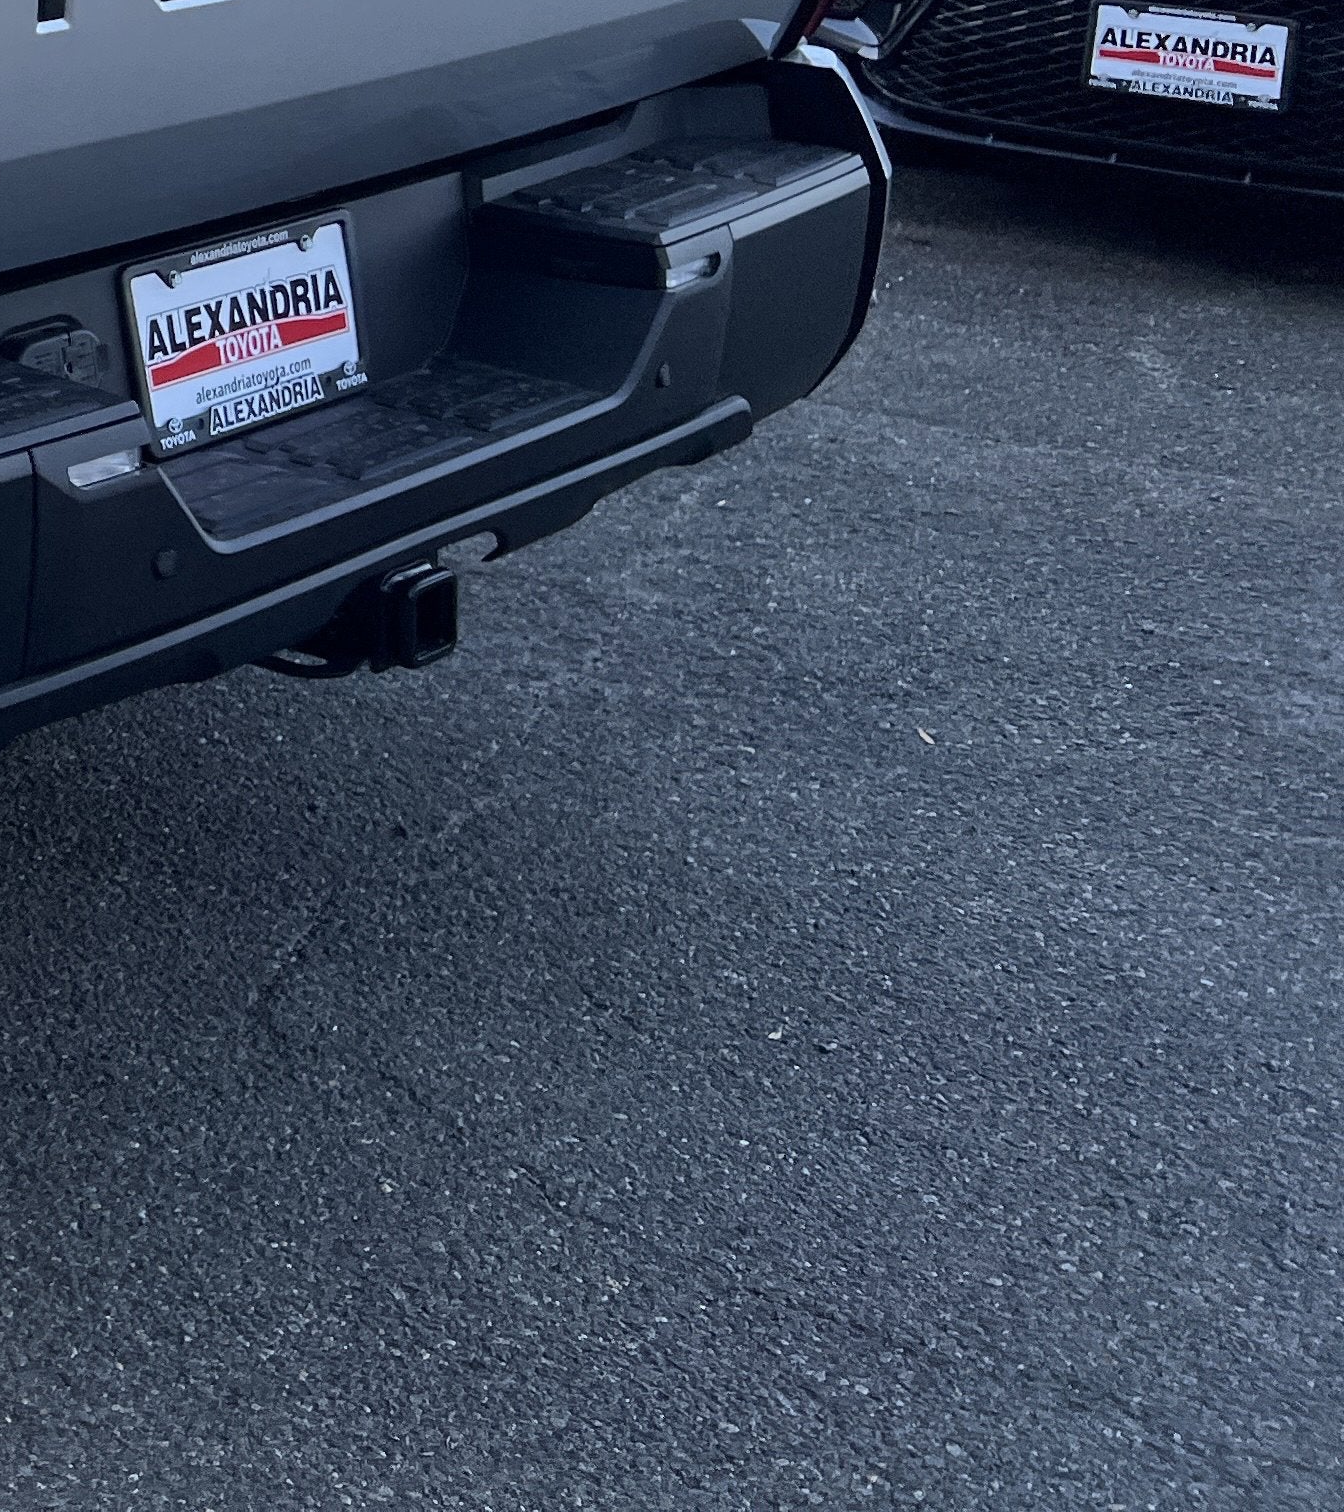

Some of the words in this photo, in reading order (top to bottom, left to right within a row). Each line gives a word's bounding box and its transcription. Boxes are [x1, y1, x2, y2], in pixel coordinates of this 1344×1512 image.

[1101, 28, 1276, 66] ALEXANDRIA
[1158, 52, 1216, 72] TOYOTA
[1130, 80, 1234, 105] ALEXANDRIA
[190, 230, 289, 265] alexandriatoyota.com
[147, 268, 344, 362] ALEXANDRIA
[214, 324, 282, 365] TOYOTA
[196, 357, 311, 405] alexandriatoyota.com
[335, 372, 368, 391] TOYOTA
[211, 376, 323, 433] ALEXANDRIA
[160, 430, 196, 450] TOYOTA
